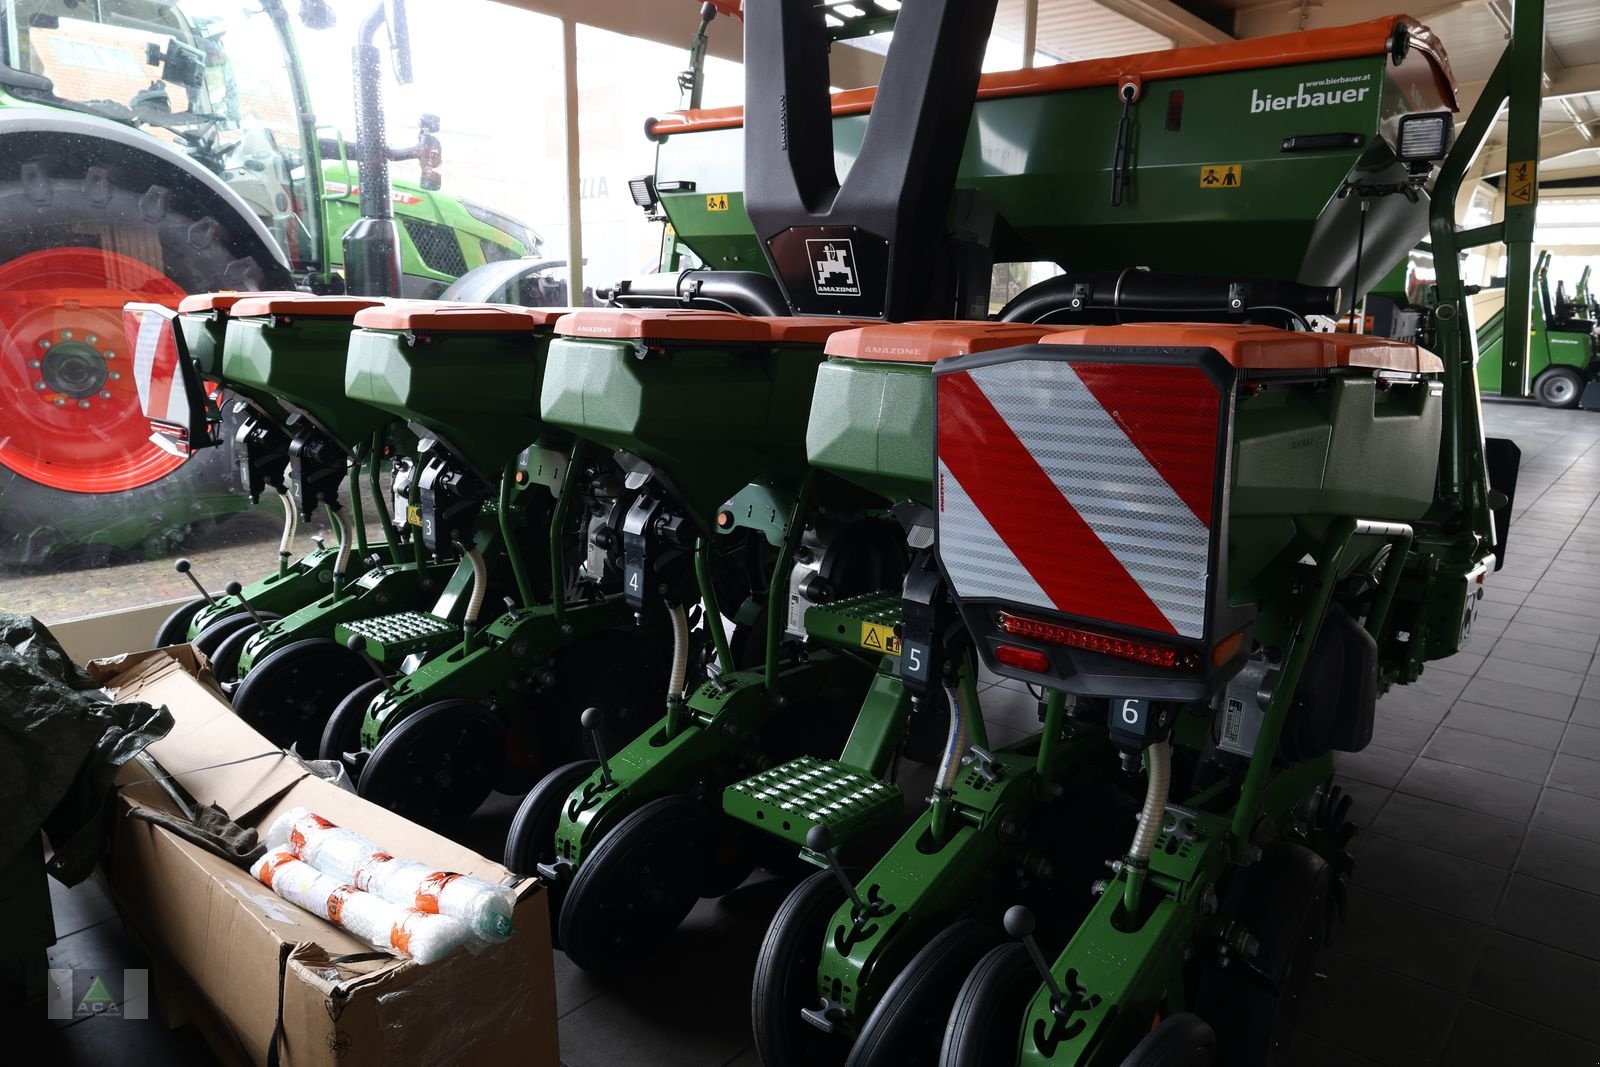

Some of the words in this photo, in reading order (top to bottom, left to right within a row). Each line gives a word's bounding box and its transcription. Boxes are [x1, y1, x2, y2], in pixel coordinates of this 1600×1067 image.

[1306, 74, 1372, 88] www.bierbauer.at
[1250, 83, 1371, 114] bierbauer
[864, 346, 921, 356] AMAZONE
[426, 519, 432, 536] 3
[629, 572, 639, 592] 4
[908, 647, 922, 672] 5
[1122, 698, 1139, 724] 6
